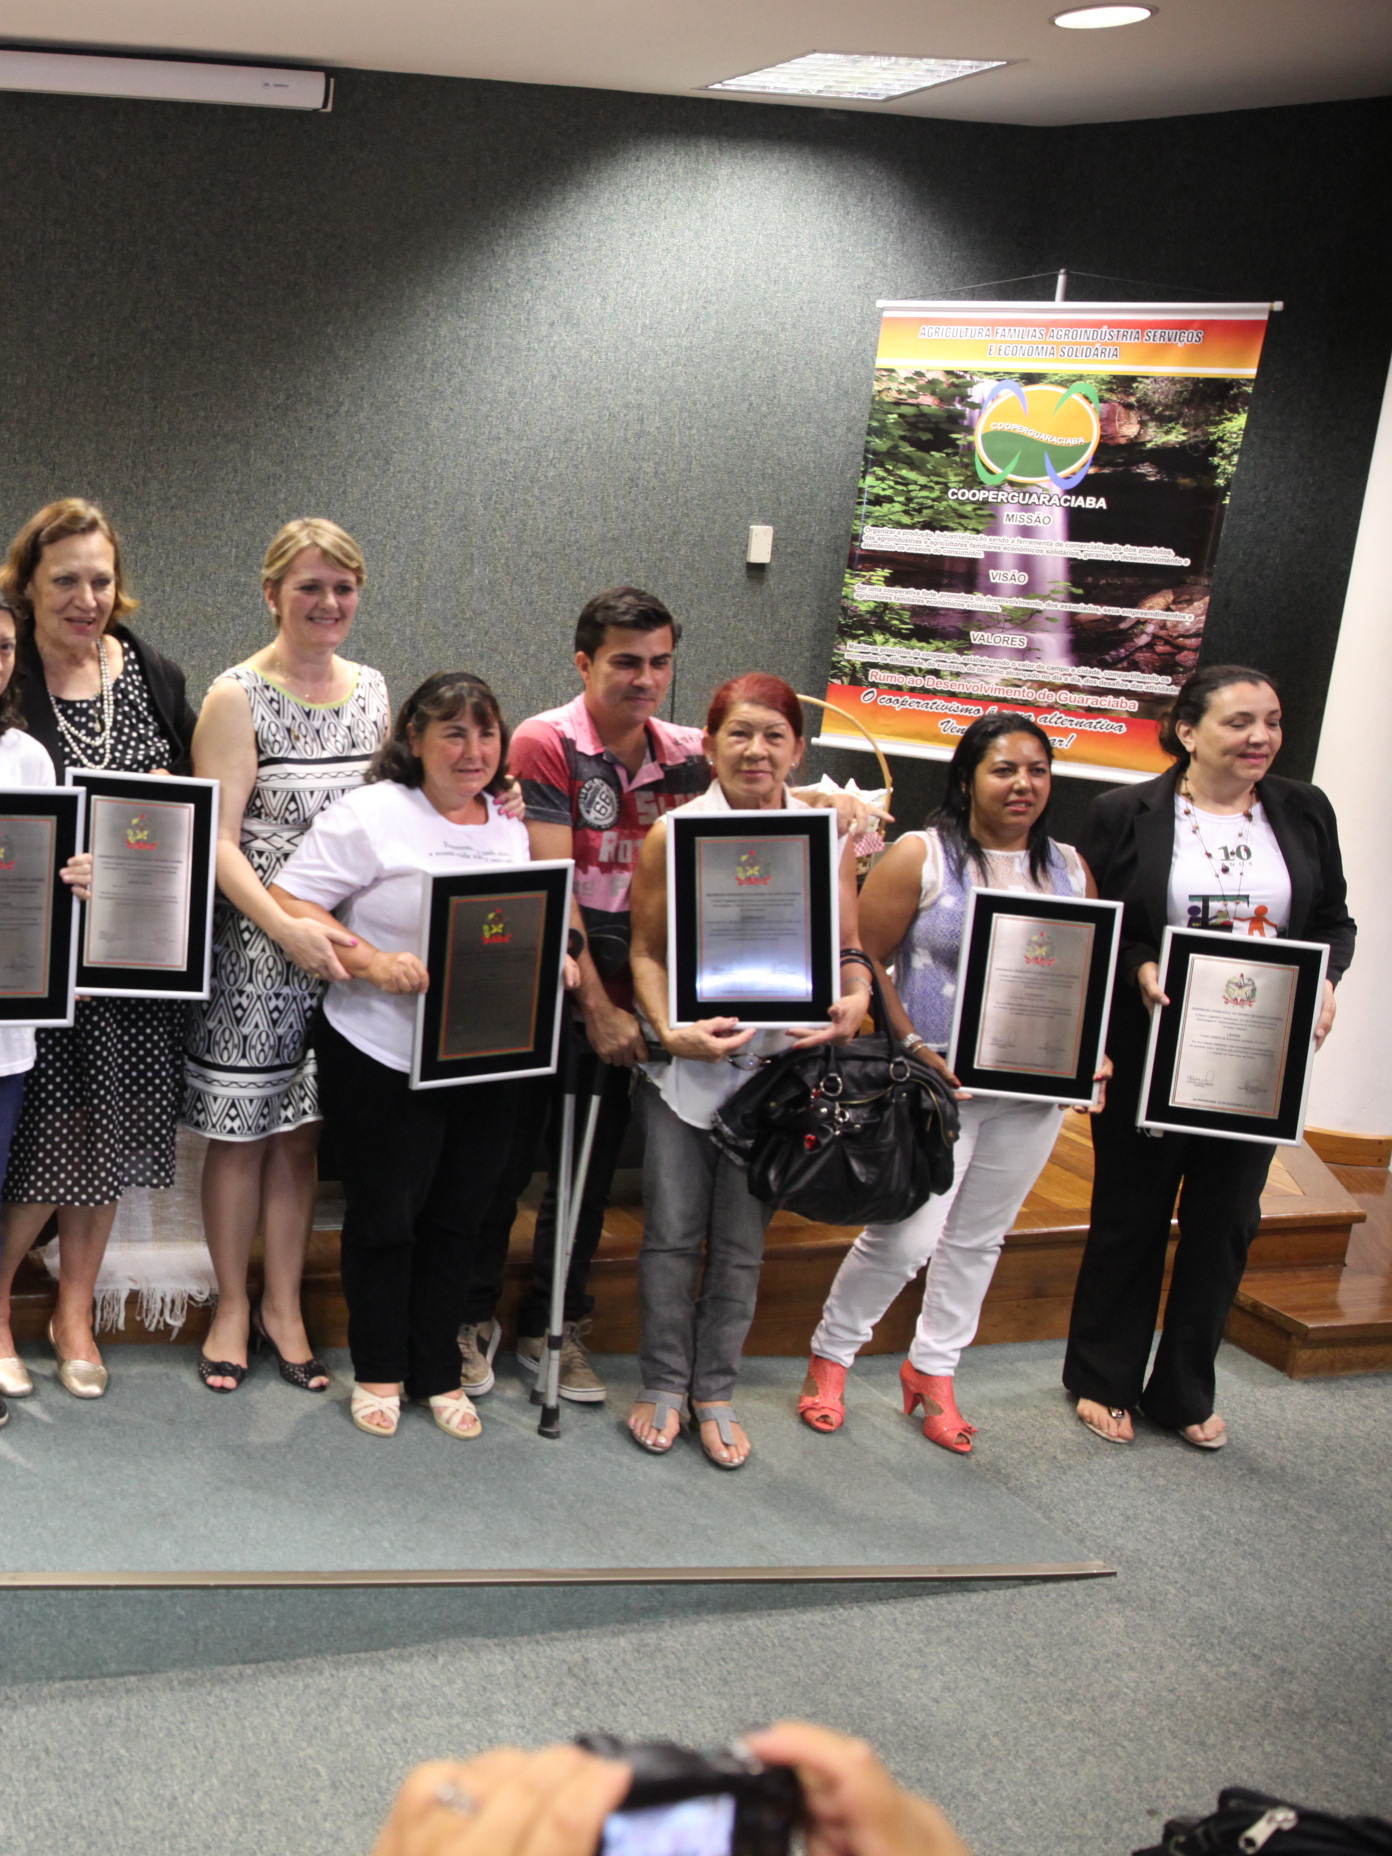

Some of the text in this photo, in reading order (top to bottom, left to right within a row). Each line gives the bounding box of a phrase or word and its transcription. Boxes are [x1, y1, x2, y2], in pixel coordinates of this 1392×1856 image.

[920, 326, 1203, 346] AGRICULTURA FAMILIAS AGROINDÚSTRIA SERVIÇOS
[988, 344, 1119, 359] E ECONOMIA SOLIDÁRIA
[990, 422, 1085, 446] COOPERGUARACIABA
[948, 488, 1107, 509] COOPERGUARACIABA
[1005, 512, 1051, 526] MISSÃO
[862, 540, 896, 550] atendendo
[906, 544, 932, 553] anseios
[942, 547, 983, 557] consumidor.
[864, 532, 875, 541] das
[930, 538, 968, 548] agricultores
[969, 540, 1001, 551] familiares
[1002, 544, 1044, 554] econômicos
[1083, 551, 1113, 559] gerando
[1120, 552, 1183, 565] desenvolvimento
[865, 525, 896, 536] Organizar
[936, 530, 987, 543] industrialização
[989, 535, 1009, 543] sendo
[1016, 536, 1053, 547] ferramenta
[1065, 541, 1122, 553] comercialização
[1123, 544, 1137, 553] dos
[1138, 546, 1174, 557] produtos,
[990, 571, 1026, 583] VISÃO
[855, 591, 892, 601] agricultores
[894, 593, 924, 604] familiares
[926, 598, 965, 608] econômicos
[856, 582, 868, 591] Ser
[884, 586, 921, 596] cooperativa
[986, 594, 1044, 608] desenvolvimento,
[1046, 599, 1058, 608] dos
[1060, 602, 1101, 614] associados,
[1103, 606, 1120, 614] seus
[1122, 608, 1186, 619] empreendimentos
[971, 632, 1026, 647] VALORES
[846, 652, 879, 662] momentos
[976, 664, 1004, 675] trabalho
[1005, 668, 1040, 679] alcançado
[1052, 672, 1063, 681] dia
[1084, 675, 1097, 685] dos
[1098, 677, 1128, 688] desafios
[1130, 680, 1143, 689] das
[848, 641, 869, 651] Manter
[962, 654, 1010, 666] estabelecendo
[1018, 659, 1034, 668] valor
[1046, 664, 1070, 673] campo
[1076, 665, 1102, 677] cidade,
[1104, 669, 1160, 681] compartilhando
[870, 670, 1137, 710] Rumo ao Desenvolvimento de Guaraciaba
[862, 689, 876, 702] O
[879, 695, 981, 715] cooperativismo
[1038, 712, 1126, 732] alternativa
[1217, 844, 1252, 861] 10
